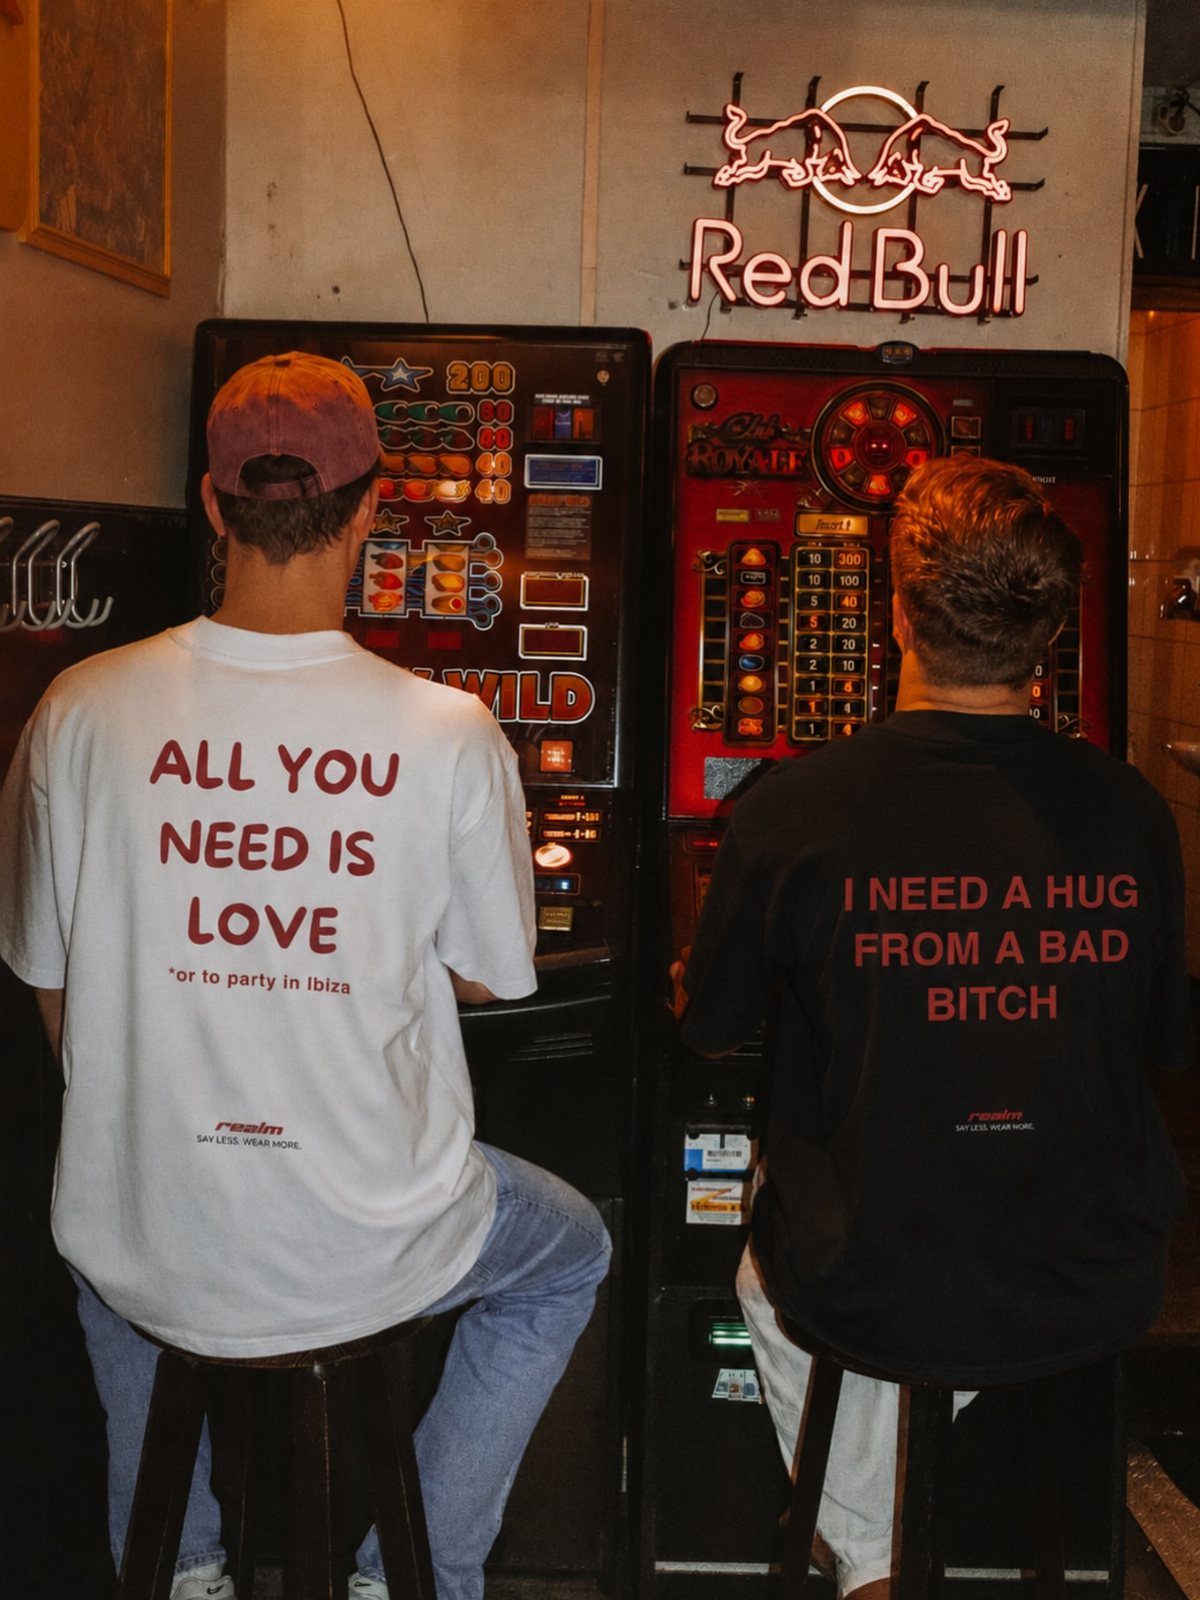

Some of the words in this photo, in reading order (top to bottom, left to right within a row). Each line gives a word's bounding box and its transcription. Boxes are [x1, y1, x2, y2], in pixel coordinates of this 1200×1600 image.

[689, 217, 854, 308] Red
[872, 227, 1028, 317] Bull
[447, 361, 515, 394] 200
[808, 553, 821, 564] 10
[838, 554, 861, 565] 300
[808, 574, 821, 585] 10
[840, 575, 860, 586] 100
[810, 596, 818, 606] 5
[842, 596, 857, 608] 40
[810, 616, 818, 628] 5
[842, 617, 857, 629] 20
[809, 638, 817, 649] 2
[842, 638, 856, 650] 20
[809, 659, 817, 670] 2
[843, 660, 855, 671] 10
[442, 669, 595, 724] WILD
[149, 739, 256, 791] ALL
[277, 743, 400, 797] YOU
[160, 819, 309, 872] NEED
[329, 829, 375, 877] IS
[844, 877, 854, 912] I
[869, 876, 988, 912] NEED
[1001, 875, 1032, 910] A
[1046, 874, 1138, 909] HUG
[188, 896, 339, 954] LOVE
[854, 931, 980, 968] FROM
[994, 930, 1025, 965] A
[1039, 929, 1129, 964] BAD
[201, 969, 220, 984] to
[227, 972, 276, 991] party
[283, 974, 300, 990] in
[307, 976, 351, 994] Ibiza
[927, 984, 1058, 1022] BITCH
[967, 1109, 1023, 1121] realm
[215, 1121, 284, 1135] realm
[955, 1123, 970, 1132] SAY
[989, 1123, 1012, 1131] WEAR
[196, 1134, 215, 1144] SAY
[215, 1135, 240, 1145] LESS.
[242, 1137, 271, 1148] WEAR
[272, 1140, 302, 1150] MORE.
